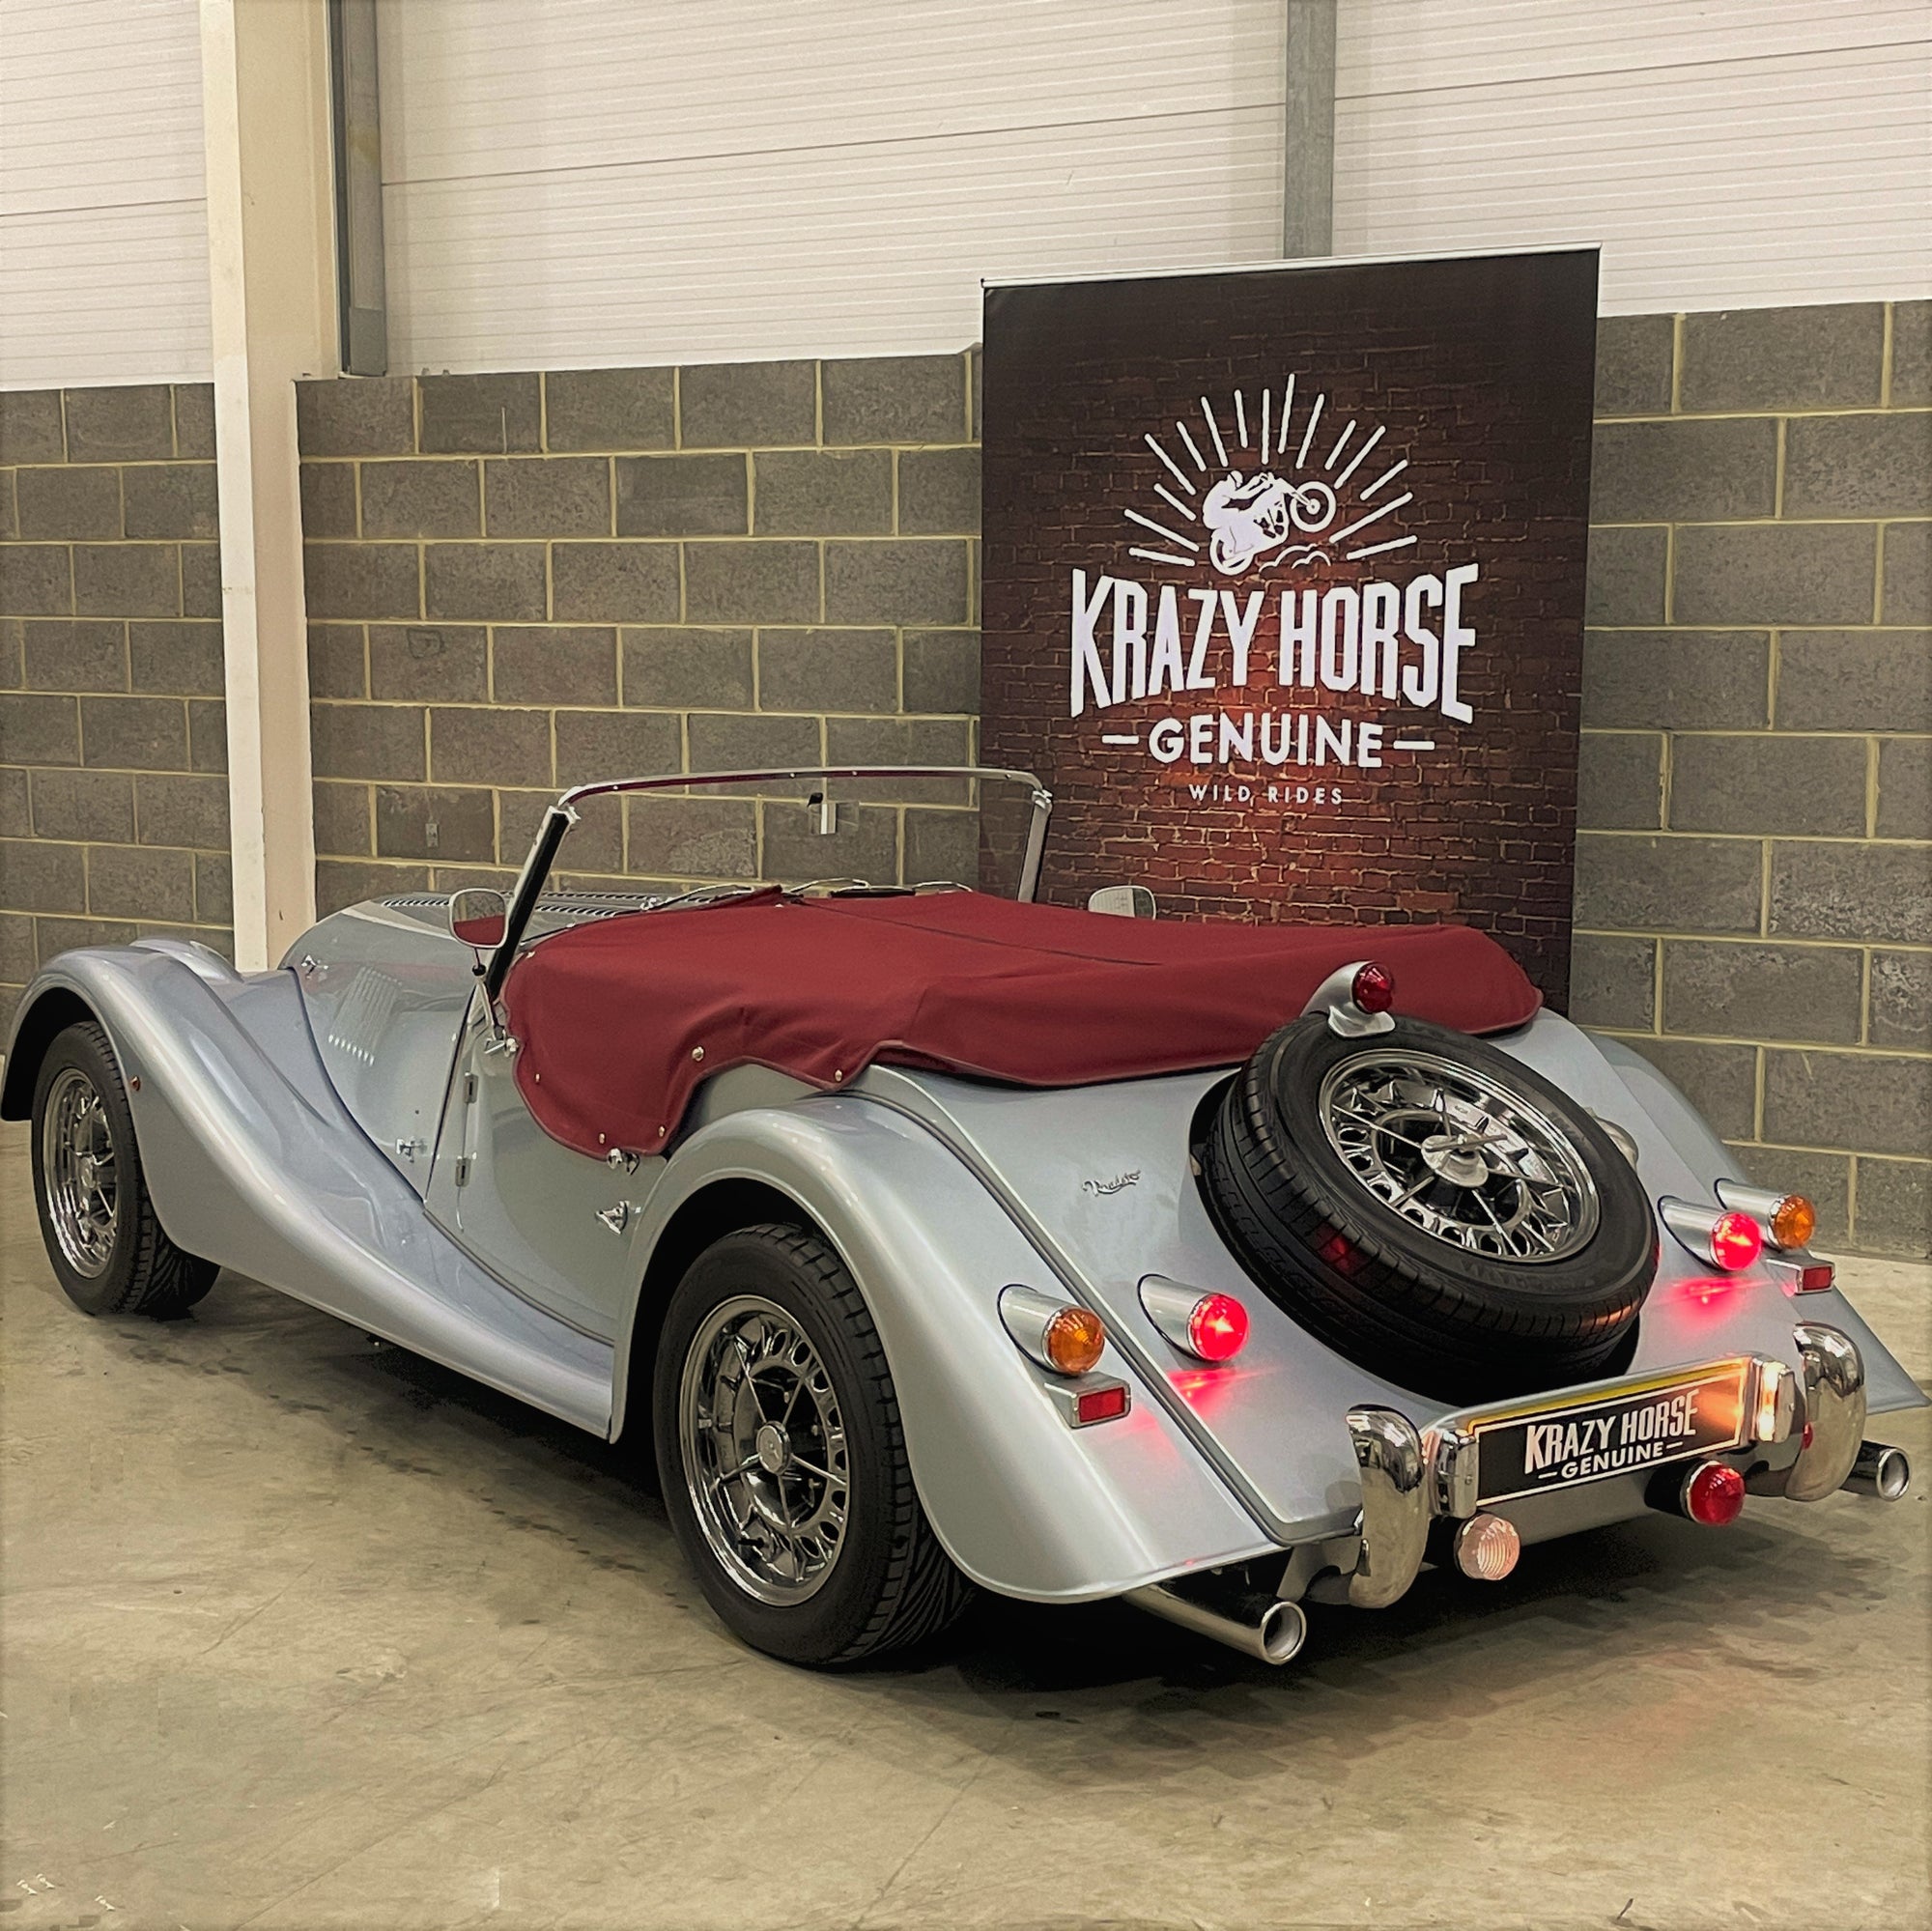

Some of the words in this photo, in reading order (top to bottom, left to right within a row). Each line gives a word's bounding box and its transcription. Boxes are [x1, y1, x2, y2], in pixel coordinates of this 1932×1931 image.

[1070, 568, 1264, 718] KRAZY
[1279, 562, 1479, 724] HORSE
[1149, 712, 1383, 768] GENUINE
[1188, 783, 1251, 803] WILD
[1267, 785, 1344, 806] RIDES
[1524, 1415, 1616, 1474] KRAZY
[1621, 1389, 1699, 1445] HORSE
[1561, 1442, 1663, 1479] GENUINE
